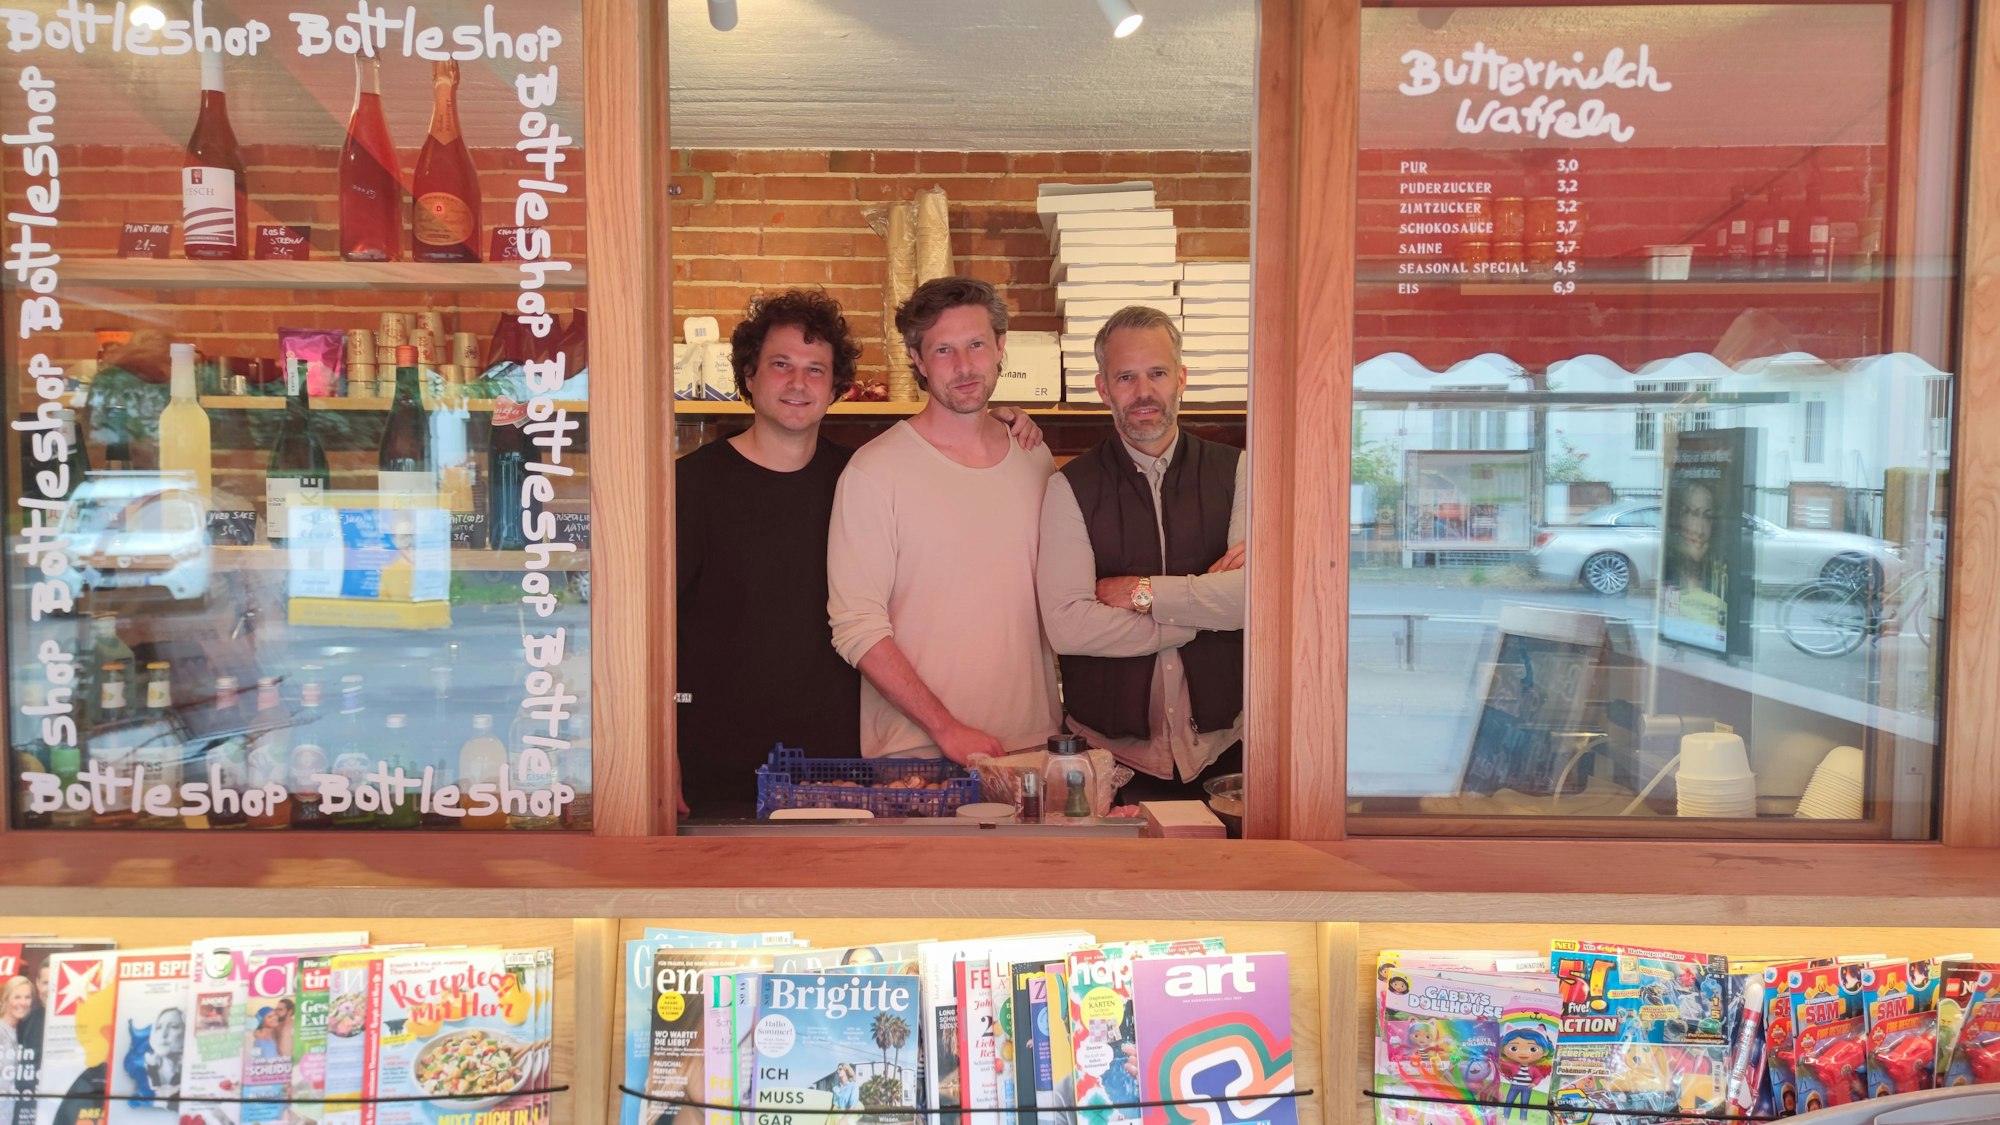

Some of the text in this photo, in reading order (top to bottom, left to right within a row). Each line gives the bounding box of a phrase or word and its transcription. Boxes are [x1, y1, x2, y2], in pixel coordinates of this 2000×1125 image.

[4, 0, 562, 62] Bottleshop Bottleshop
[1399, 41, 1672, 96] Buttermilch
[1456, 95, 1635, 142] Waffeln
[1401, 159, 1579, 174] PUR 3,0
[1400, 180, 1578, 194] PUDERZUCKER 3,2
[1399, 200, 1578, 214] ZIMTZUCKER 3,2
[1399, 220, 1578, 235] SCHOKOSAUCE 3,7
[1399, 241, 1577, 255] SAHNE 3,7
[1399, 261, 1576, 274] SEASONAL SPECIAL 4,5
[1398, 281, 1575, 294] EIS 6,9
[2, 66, 76, 747] shop Bottleshop Bottleshop
[515, 66, 580, 782] Bottleshop Bottleshop Bottle
[22, 760, 575, 817] Bottleshop Bottleshop
[1555, 942, 1576, 950] NEU
[120, 963, 157, 979] DER
[1165, 955, 1256, 997] art
[389, 965, 489, 1009] Rezepte
[770, 977, 909, 1019] Brigitte
[1425, 986, 1491, 1006] GABBY'S
[460, 992, 513, 1018] Herz
[1088, 1000, 1116, 1009] KARTEN
[1408, 994, 1504, 1018] DOLLHOUSE
[1877, 998, 1908, 1019] SAM
[1805, 1002, 1840, 1024] SAM
[757, 1027, 793, 1036] Sommer!
[765, 1020, 786, 1028] Hallo
[655, 1030, 698, 1039] WO WARTET
[668, 1039, 690, 1047] LIEBE?
[760, 1068, 789, 1080] ICH
[759, 1092, 804, 1104] MUSS
[758, 1114, 793, 1125] GAR
